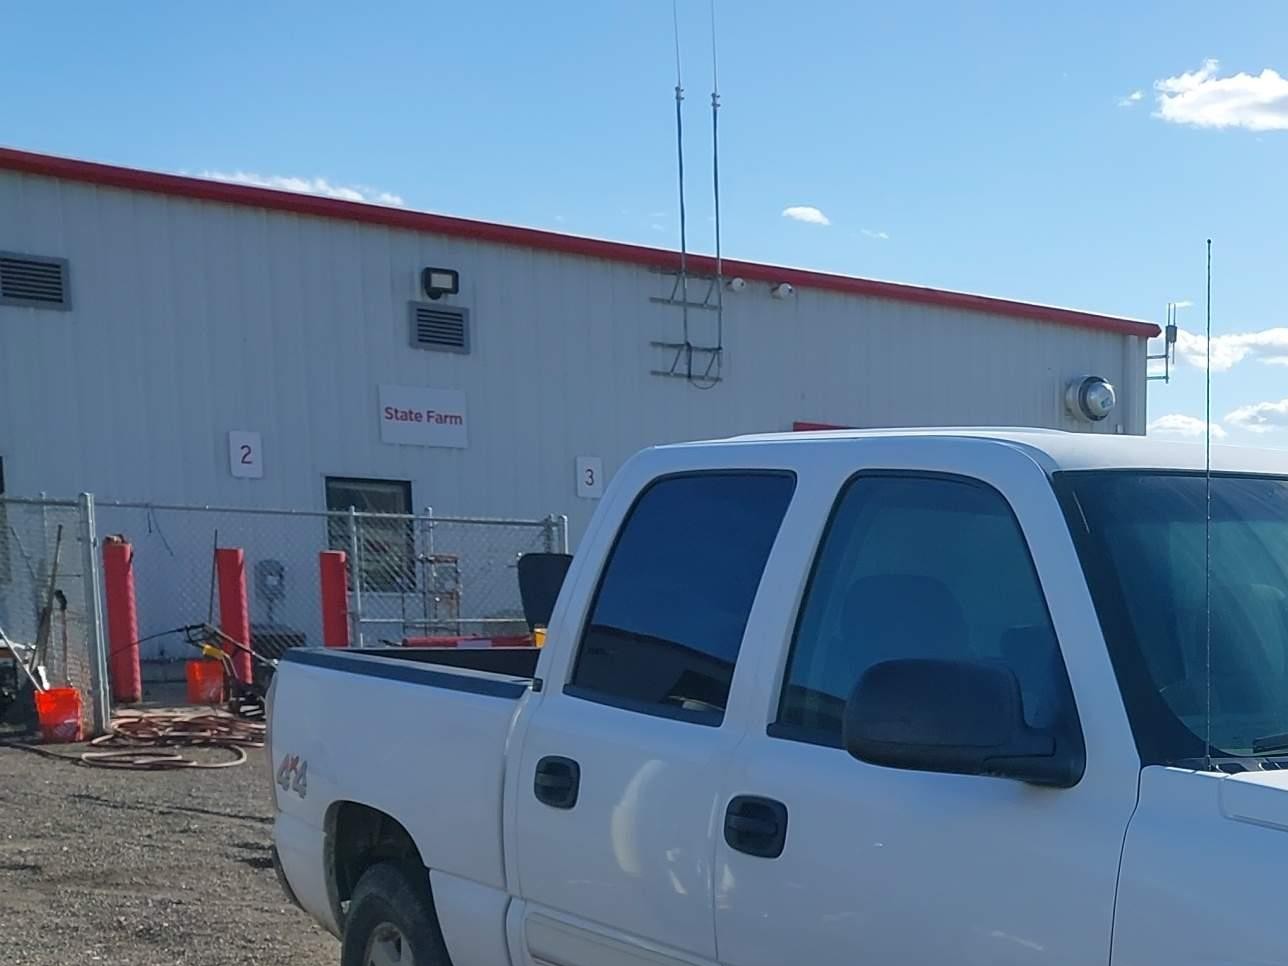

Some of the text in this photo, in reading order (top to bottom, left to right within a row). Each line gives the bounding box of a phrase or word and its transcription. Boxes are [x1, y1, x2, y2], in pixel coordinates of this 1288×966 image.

[384, 406, 463, 425] State Farm
[240, 444, 253, 464] 2
[584, 468, 594, 486] 3
